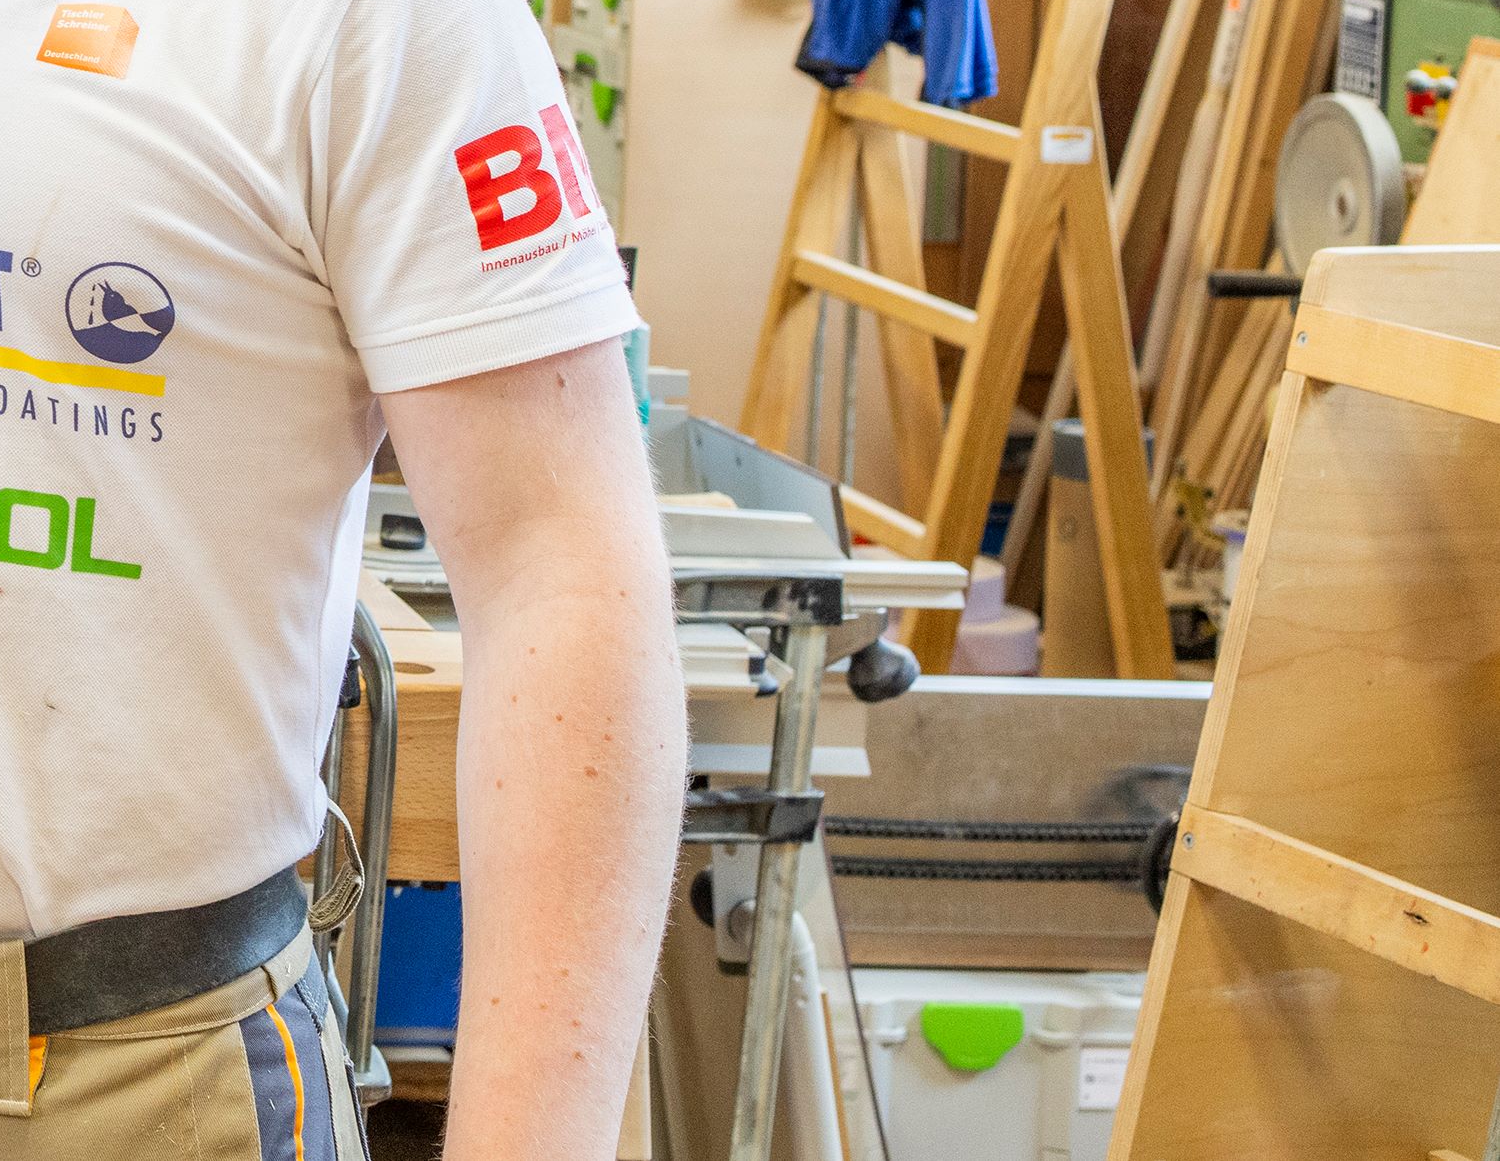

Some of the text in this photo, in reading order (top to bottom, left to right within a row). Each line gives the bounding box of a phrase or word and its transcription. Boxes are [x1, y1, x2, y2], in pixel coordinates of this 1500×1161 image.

[61, 8, 105, 19] Tischler
[56, 19, 110, 32] Schreiner
[43, 49, 101, 64] Deutschland
[480, 241, 560, 272] Innenausbau
